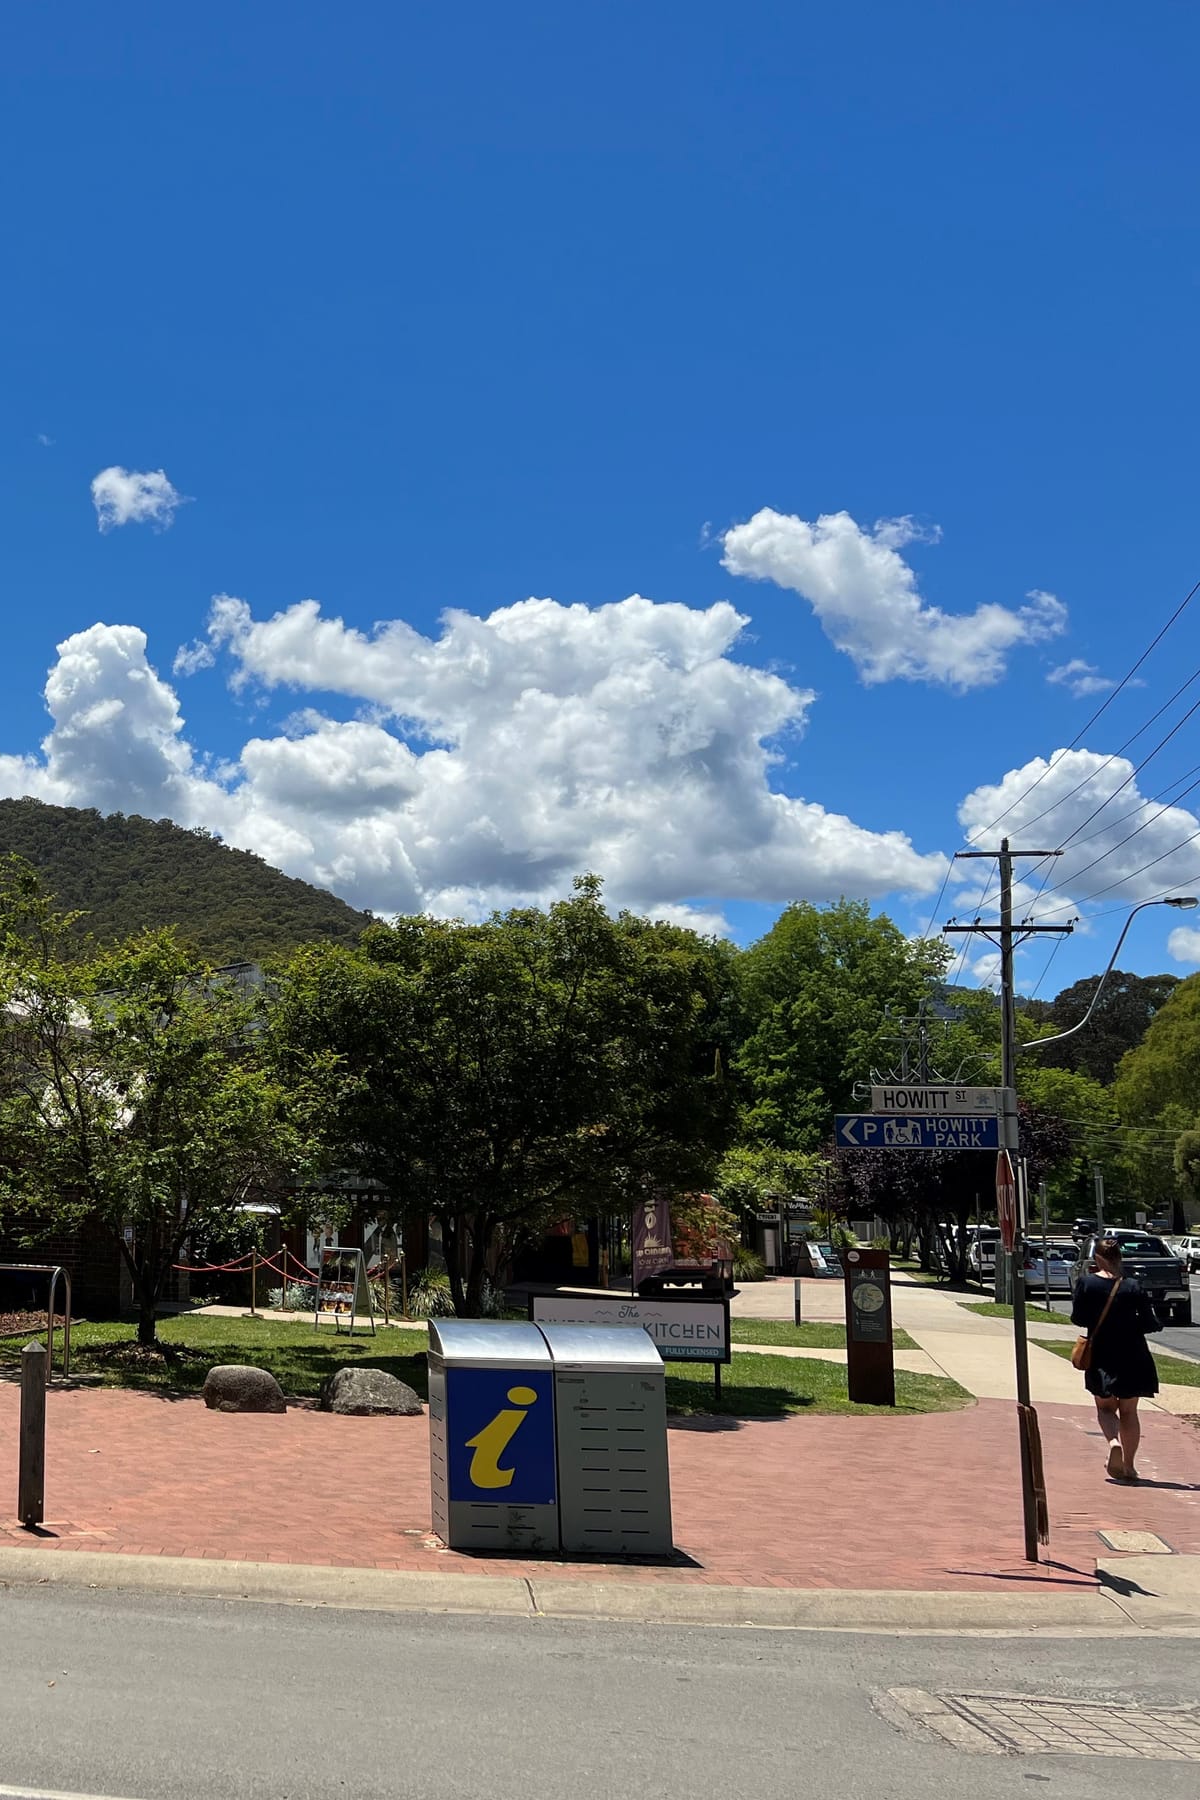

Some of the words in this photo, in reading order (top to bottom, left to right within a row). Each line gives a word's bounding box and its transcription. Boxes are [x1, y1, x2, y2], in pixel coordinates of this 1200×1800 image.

[883, 1090, 949, 1108] HOWITT
[956, 1091, 966, 1100] ST
[926, 1119, 990, 1132] HOWITT
[935, 1133, 982, 1147] PARK
[618, 1305, 640, 1318] The
[642, 1322, 720, 1340] KITCHEN
[687, 1348, 719, 1356] LICENSED
